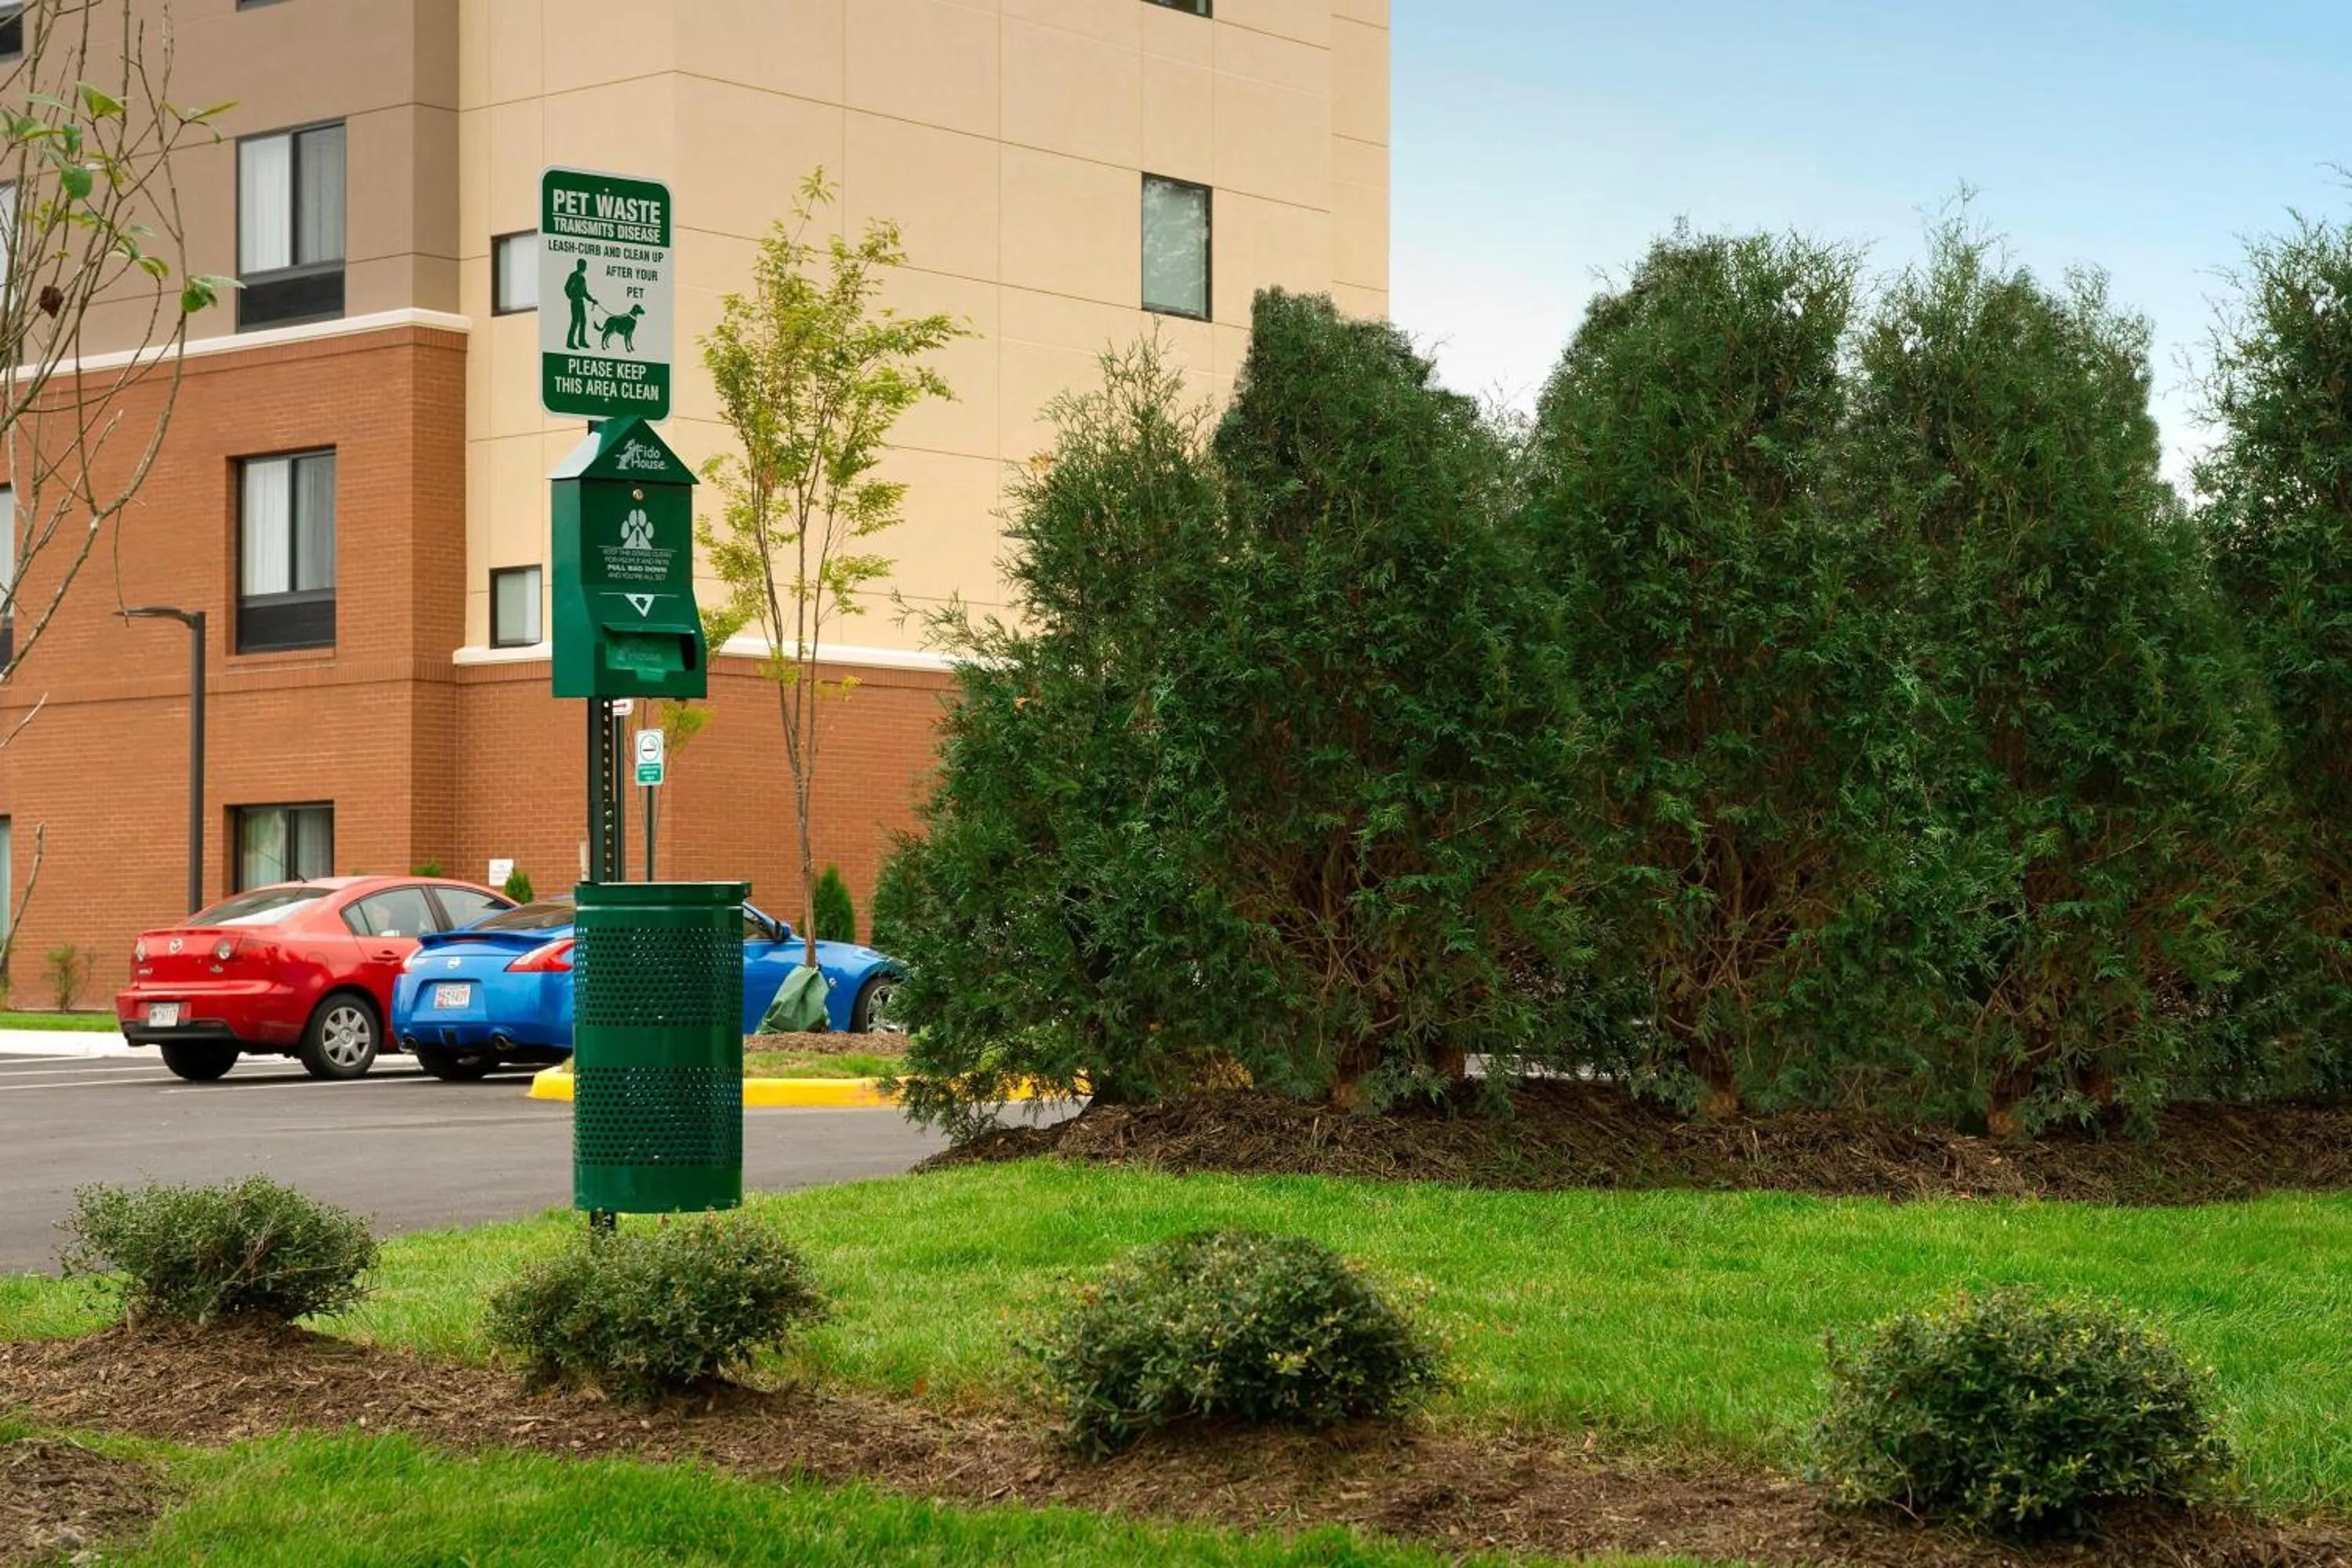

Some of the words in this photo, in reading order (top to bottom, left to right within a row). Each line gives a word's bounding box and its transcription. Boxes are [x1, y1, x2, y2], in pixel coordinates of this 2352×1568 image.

[553, 188, 590, 215] PET
[596, 194, 660, 224] WASTE
[554, 217, 614, 238] TRANSMITS
[617, 224, 660, 243] DISEASE
[549, 239, 601, 256] LEASH-CURB
[604, 246, 621, 258] AND
[623, 248, 650, 261] CLEAN
[652, 252, 664, 263] UP
[606, 265, 633, 278] AFTER
[635, 269, 658, 281] YOUR
[627, 287, 644, 299] PET
[568, 358, 614, 377] PLEASE
[617, 363, 647, 380] KEEP
[555, 376, 583, 394] THIS
[586, 379, 618, 397] AREA
[621, 382, 659, 401] CLEAN
[636, 444, 661, 459] Fido
[630, 457, 666, 470] House
